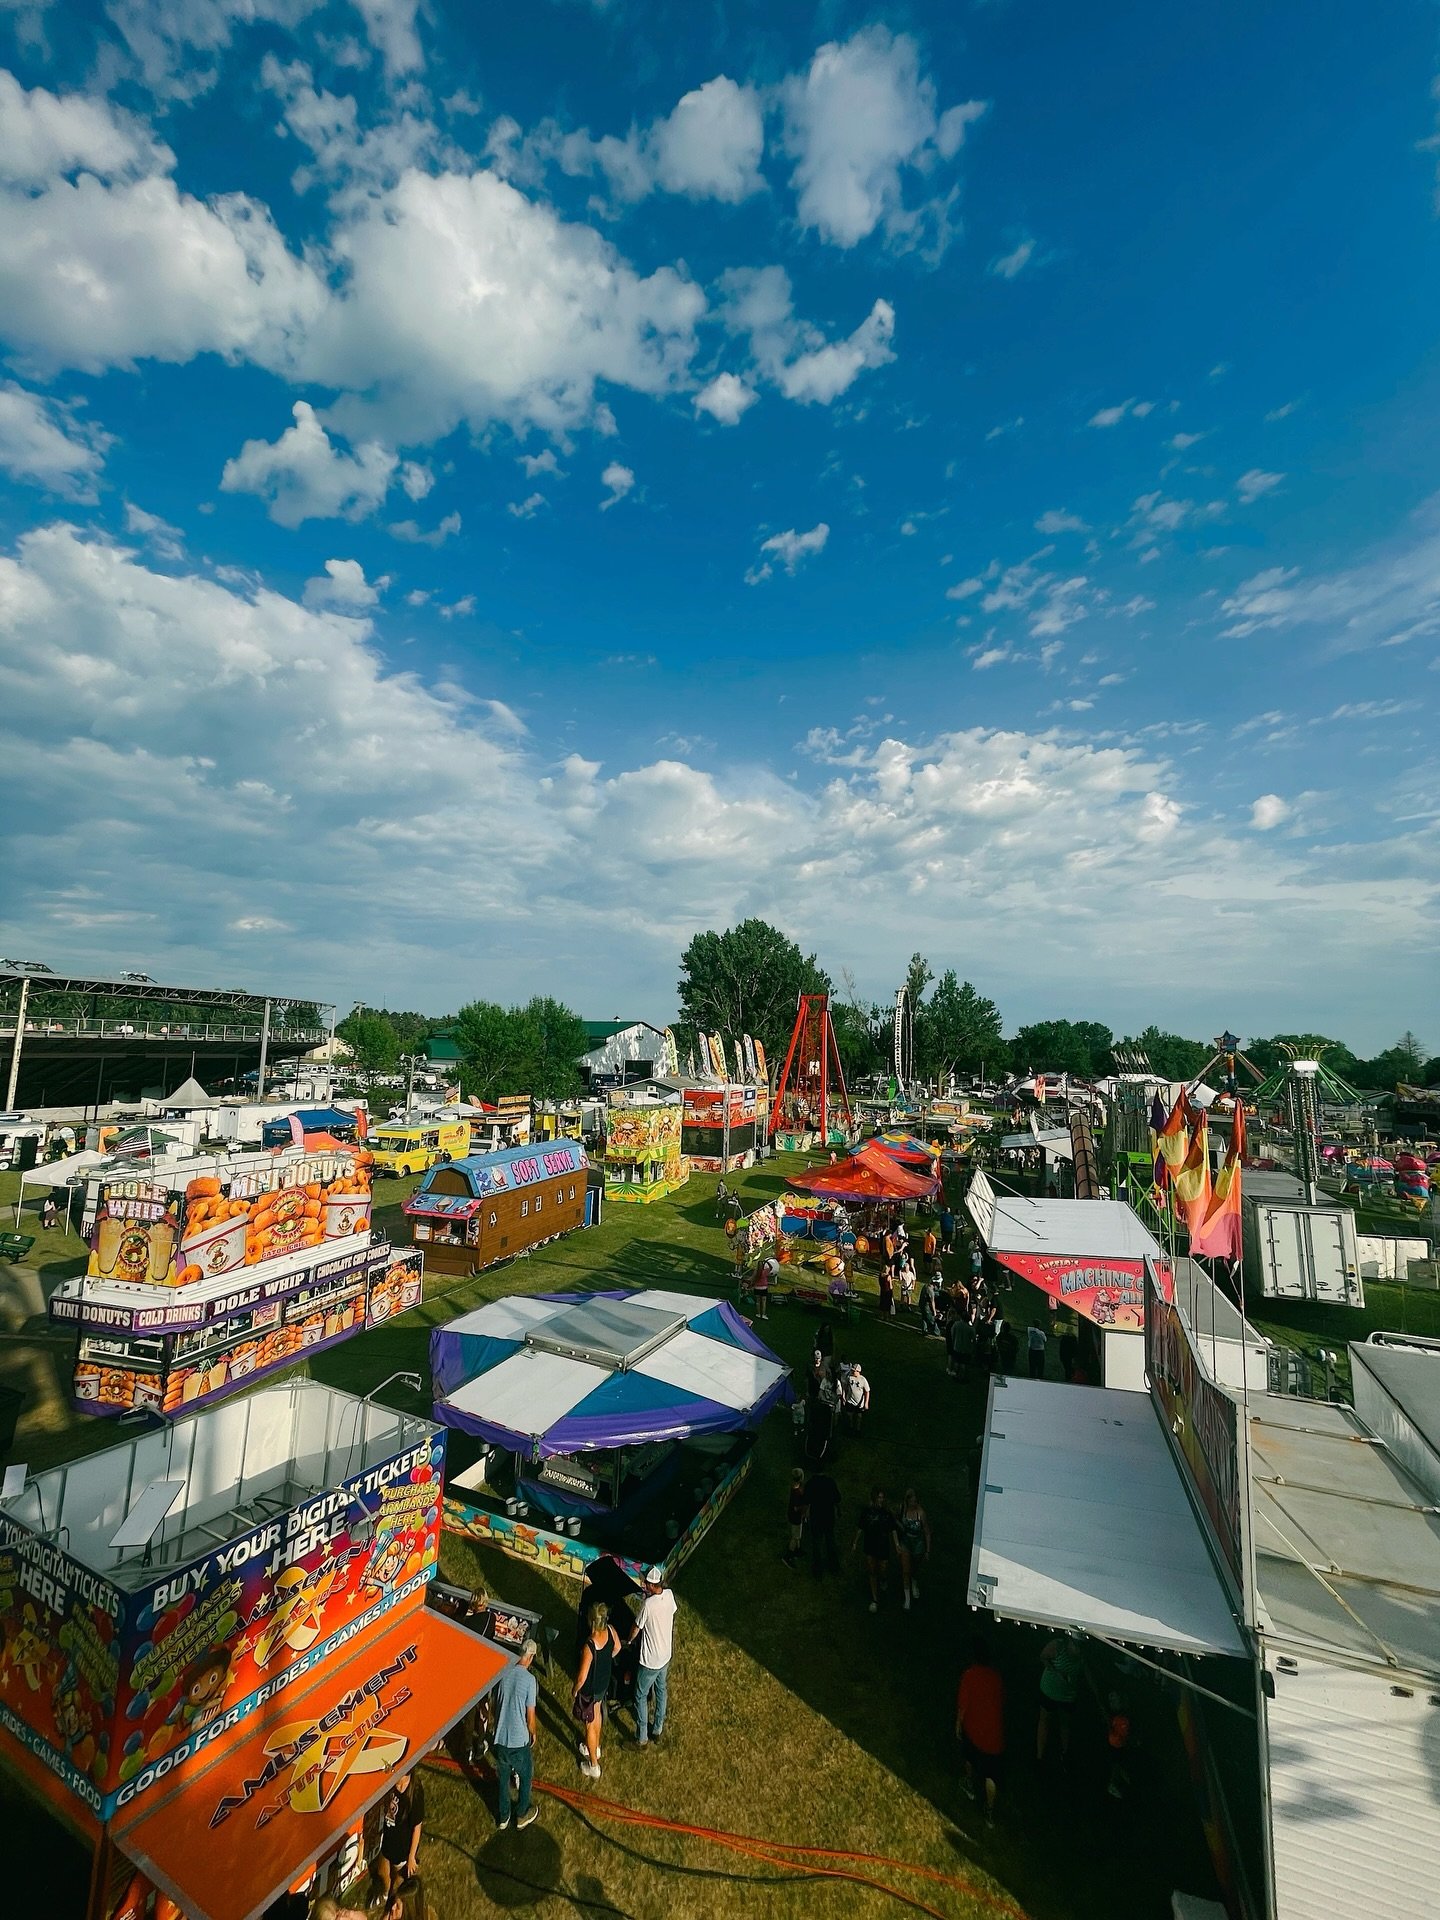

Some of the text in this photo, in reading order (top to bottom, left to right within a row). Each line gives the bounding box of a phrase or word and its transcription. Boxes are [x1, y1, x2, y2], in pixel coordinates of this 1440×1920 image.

[229, 1168, 280, 1201] MINI
[282, 1159, 356, 1191] DONUTS
[511, 1150, 575, 1185] SOFT SERVE
[107, 1200, 166, 1220] WHIP
[108, 1181, 168, 1202] DOLE
[261, 1240, 309, 1259] GATOR GRILL
[317, 1244, 391, 1279] CHOCOLATE CHIP COOKIES
[214, 1290, 260, 1316] DOLE
[265, 1273, 305, 1297] WHIP
[1060, 1268, 1135, 1296] MACHINE
[53, 1301, 131, 1327] MINI DONUTS
[139, 1305, 201, 1326] COLD DRINKS
[380, 1495, 437, 1516] ARMBANDS
[383, 1481, 436, 1500] PURCHASE
[152, 1444, 429, 1613] BUY YOUR DIGITAL TICKETS
[391, 1513, 416, 1527] HERE
[443, 1512, 539, 1556] GOLD
[272, 1511, 346, 1574] HERE
[20, 1562, 66, 1616] HERE
[32, 1543, 71, 1586] DIGITAL
[73, 1569, 119, 1618] TICKETS
[224, 1535, 377, 1640] AMUSEMENT
[135, 1578, 233, 1676] PURCHASE
[139, 1587, 243, 1688] ARMBANDS
[171, 1624, 219, 1676] HERE
[117, 1570, 430, 1806] GOOD FOR RIDES GAMES FOOD
[208, 1644, 417, 1829] AMUSEMENT
[254, 1686, 412, 1829] ATTRACTIONS
[2, 1711, 102, 1810] RIDES GAMES FOOD
